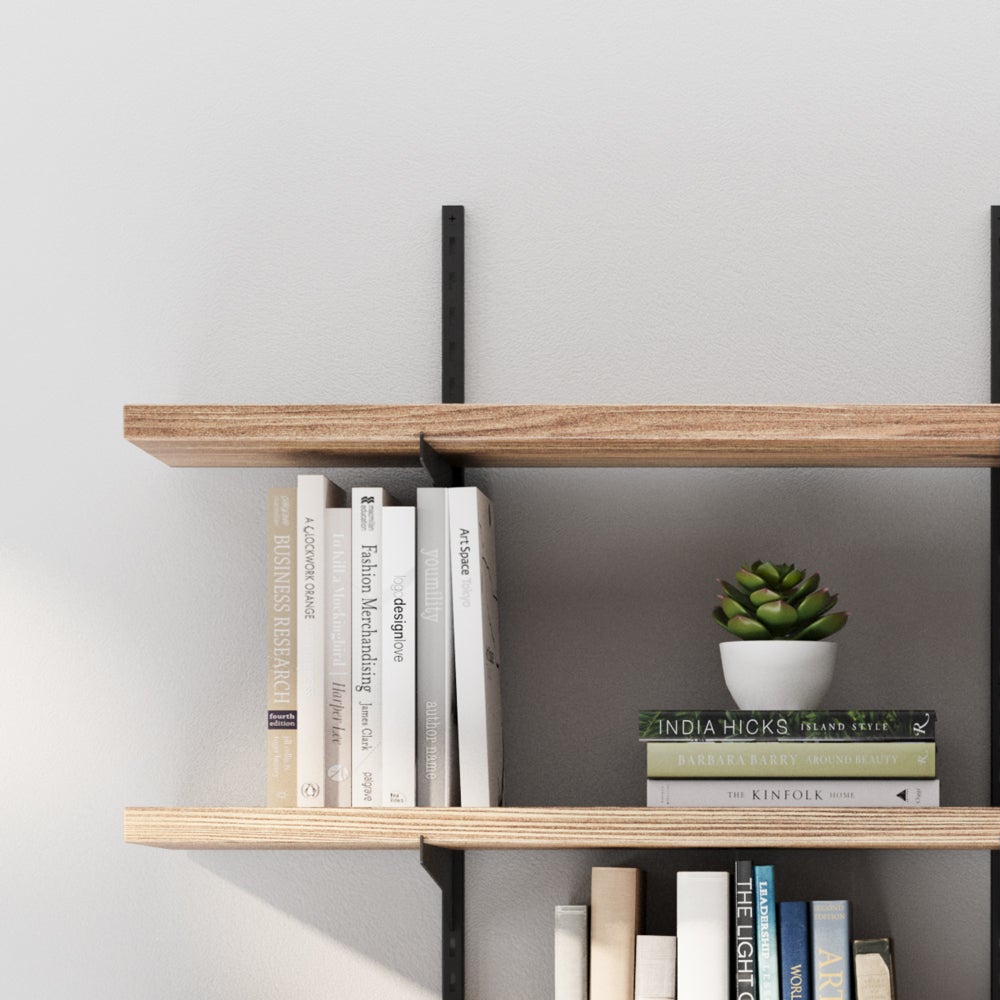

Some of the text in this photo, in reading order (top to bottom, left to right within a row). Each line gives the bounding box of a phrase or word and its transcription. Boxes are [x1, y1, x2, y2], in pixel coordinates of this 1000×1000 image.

[274, 535, 291, 612] BUSINESS
[304, 526, 315, 581] CLOCKWORK
[459, 528, 471, 575] Art Space
[304, 583, 315, 619] ORANGE
[355, 545, 378, 693] Fashion Merchandising
[274, 616, 291, 704] RESEARCH
[329, 682, 346, 745] Harper Lee
[359, 701, 373, 751] James Clark
[659, 718, 889, 735] INDIA HICKS ISLAND STYLE
[426, 701, 441, 780] author name
[678, 754, 745, 766] BARBARA
[750, 754, 798, 766] BARRY
[855, 753, 898, 765] BEAUTY
[363, 772, 372, 801] palgrave
[752, 789, 824, 801] KINFOLK
[829, 791, 856, 799] HOME
[736, 878, 753, 918] THE
[758, 881, 770, 959] LEADERSHIP
[813, 913, 846, 921] EDITION
[737, 925, 754, 986] LIGHT
